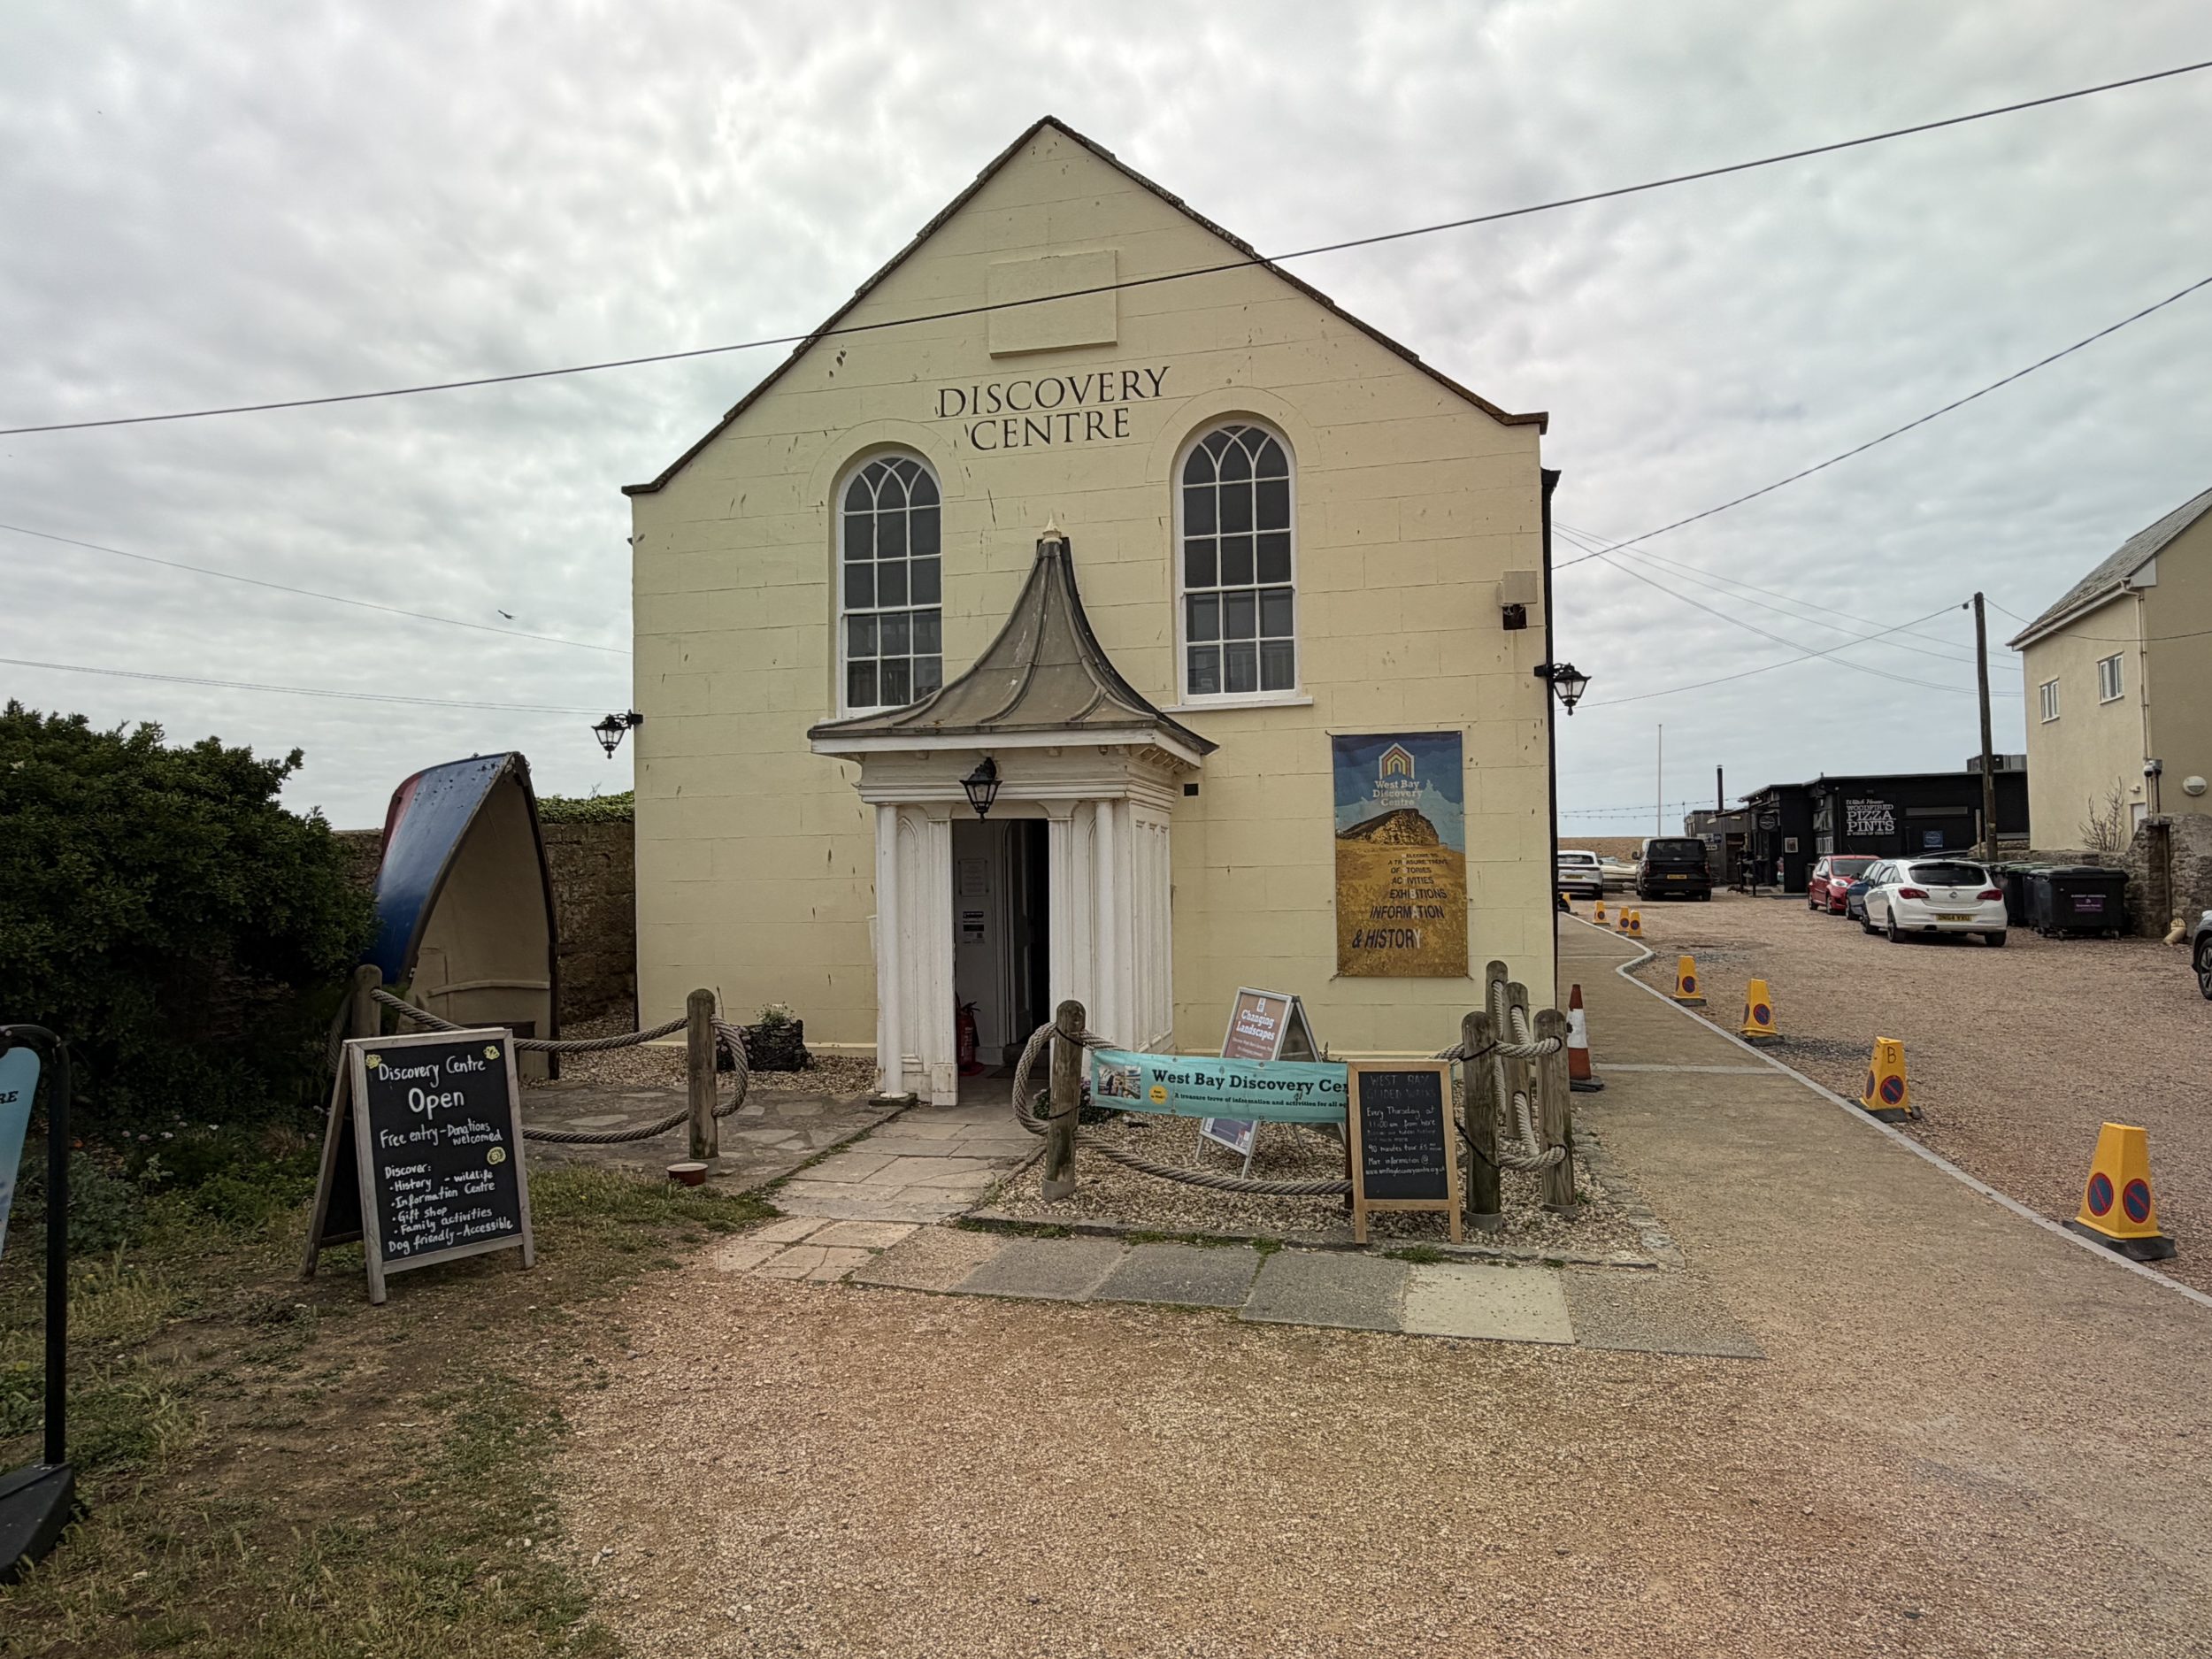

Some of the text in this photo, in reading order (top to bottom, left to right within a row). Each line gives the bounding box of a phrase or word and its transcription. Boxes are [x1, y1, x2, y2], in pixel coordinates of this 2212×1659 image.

[937, 365, 1171, 418] DISCOVERY
[971, 407, 1130, 450] CENTRE
[1401, 780, 1420, 790] Bay
[1372, 789, 1424, 799] Discovery
[1846, 810, 1896, 821] PIZZA
[1847, 820, 1894, 832] PINTS
[1389, 888, 1448, 900] EXHIBITIONS
[1370, 905, 1445, 919] INFORMATION
[1352, 928, 1421, 949] & HISTORY
[1241, 1009, 1275, 1028] Changing
[1236, 1021, 1275, 1041] Landscapes
[1887, 1046, 1896, 1064] B
[379, 1055, 486, 1088] Discovery Centre
[1152, 1069, 1190, 1085] West
[1194, 1072, 1225, 1090] Bay
[1229, 1075, 1314, 1095] Discovery
[1370, 1075, 1397, 1087] WEST
[409, 1087, 465, 1120] Open
[1366, 1104, 1434, 1120] Every Thursday at
[380, 1129, 406, 1148] Free
[410, 1125, 438, 1146] entry
[447, 1118, 490, 1137] Donations
[453, 1129, 503, 1146] welcomed
[1385, 1156, 1419, 1167] information
[1421, 1155, 1429, 1165] @
[385, 1164, 431, 1179] Discover:
[454, 1170, 493, 1182] wildlife
[396, 1181, 495, 1209] Information Centre
[397, 1207, 448, 1224] Gift shop
[401, 1208, 492, 1235] Family activities
[388, 1240, 410, 1255] Dog
[413, 1228, 455, 1250] friendly
[463, 1217, 513, 1237] Accessible
